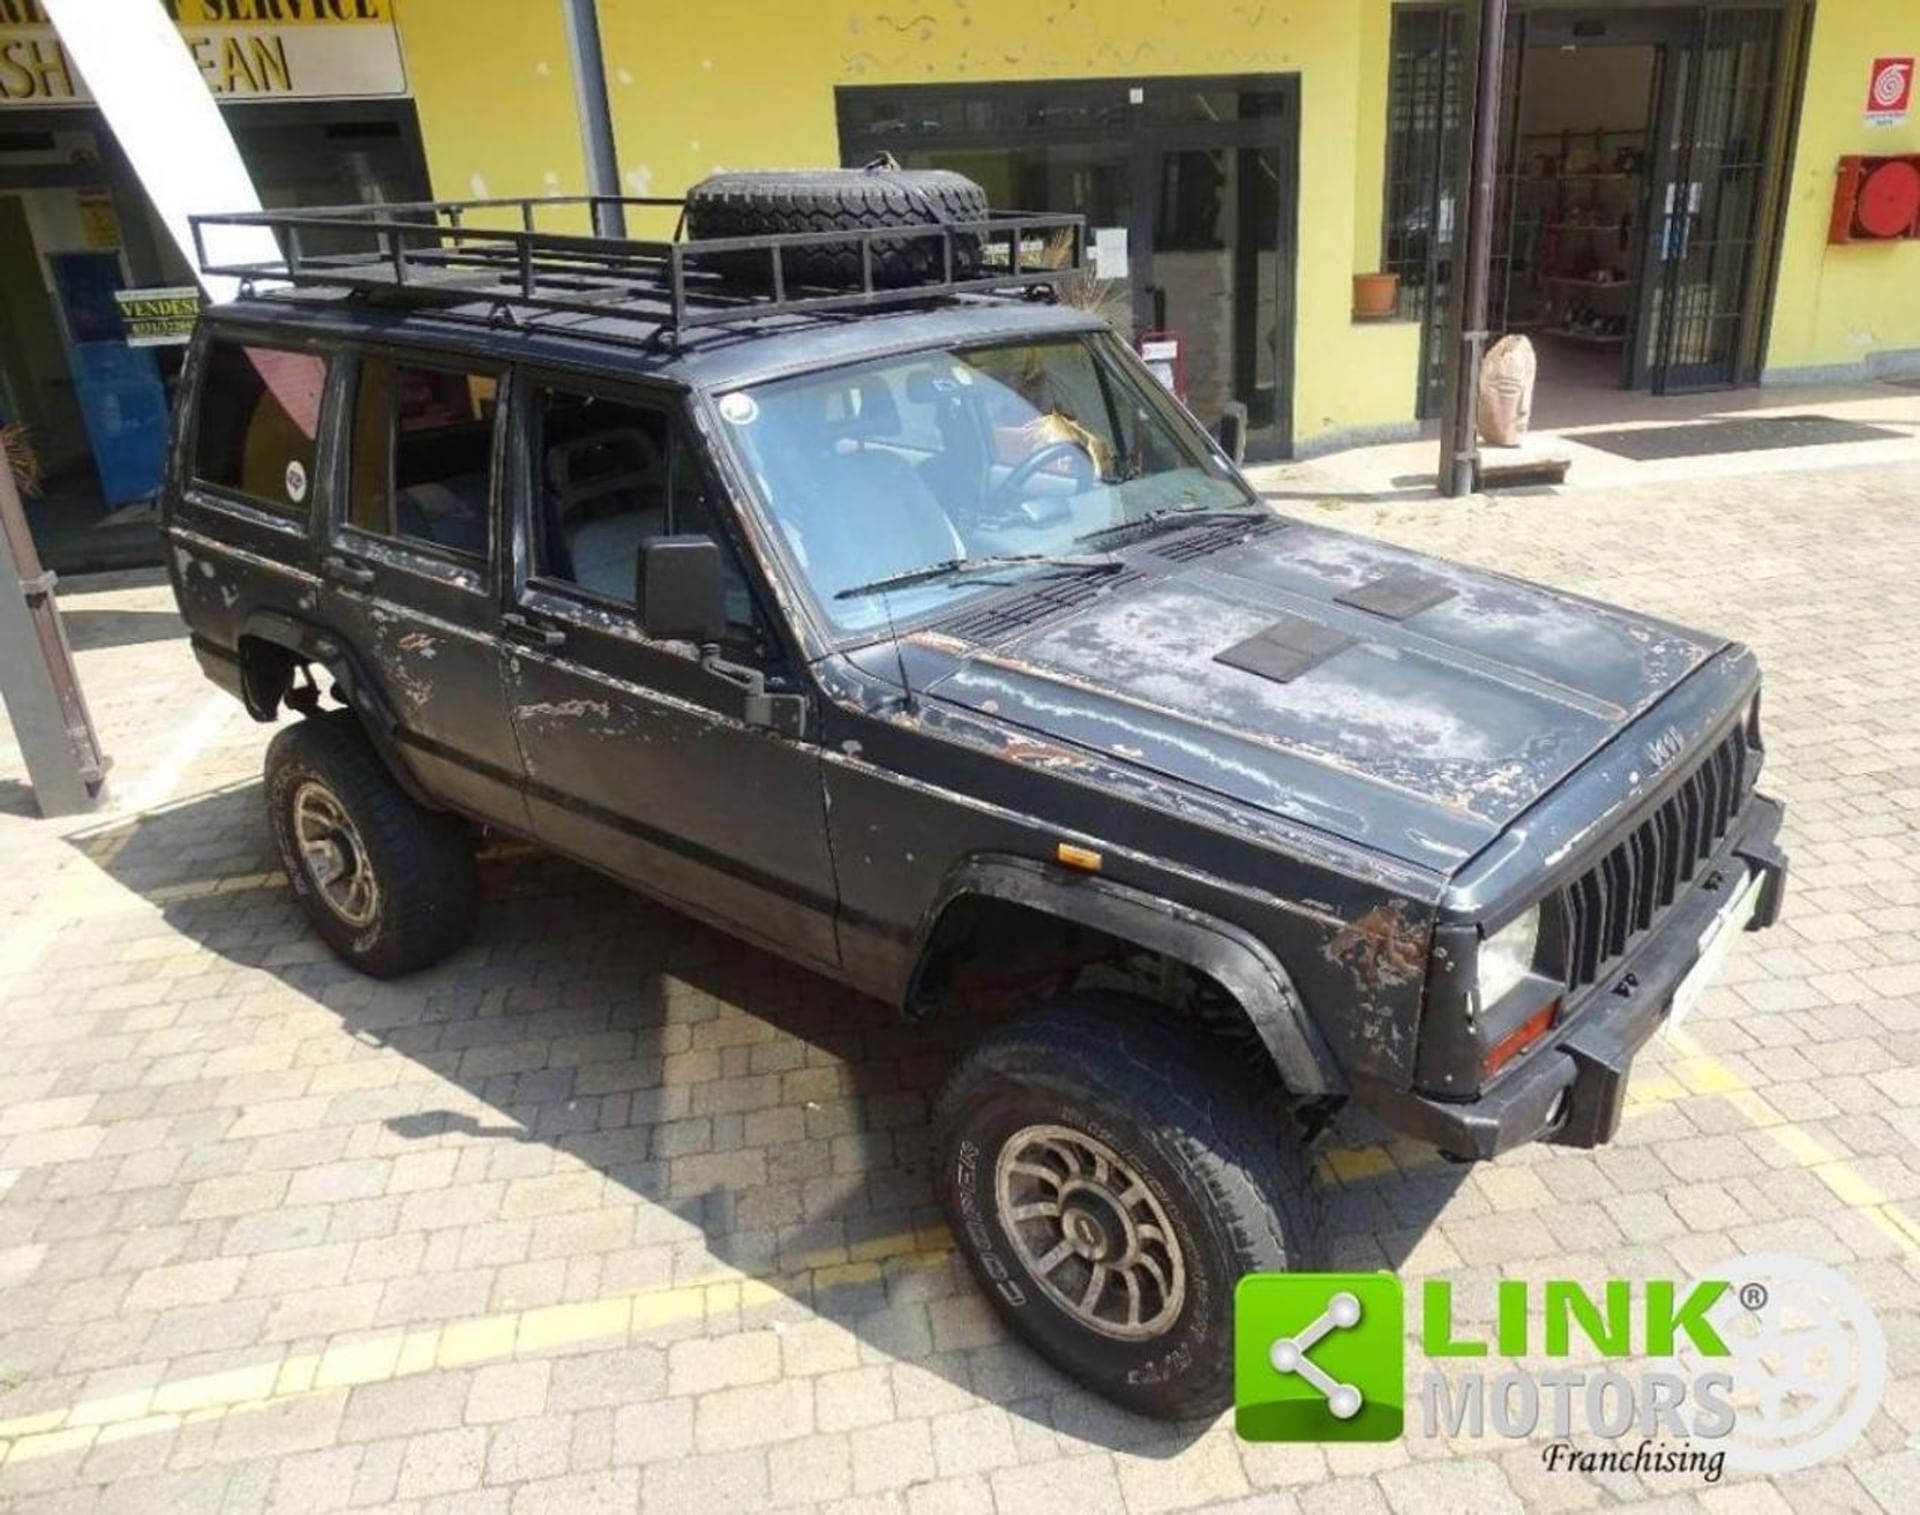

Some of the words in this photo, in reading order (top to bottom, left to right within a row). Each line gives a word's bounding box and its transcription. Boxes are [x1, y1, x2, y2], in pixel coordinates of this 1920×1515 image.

[202, 0, 379, 21] SERVICE
[0, 39, 76, 98] SH
[190, 36, 293, 93] EAN
[120, 298, 199, 317] VENDESI
